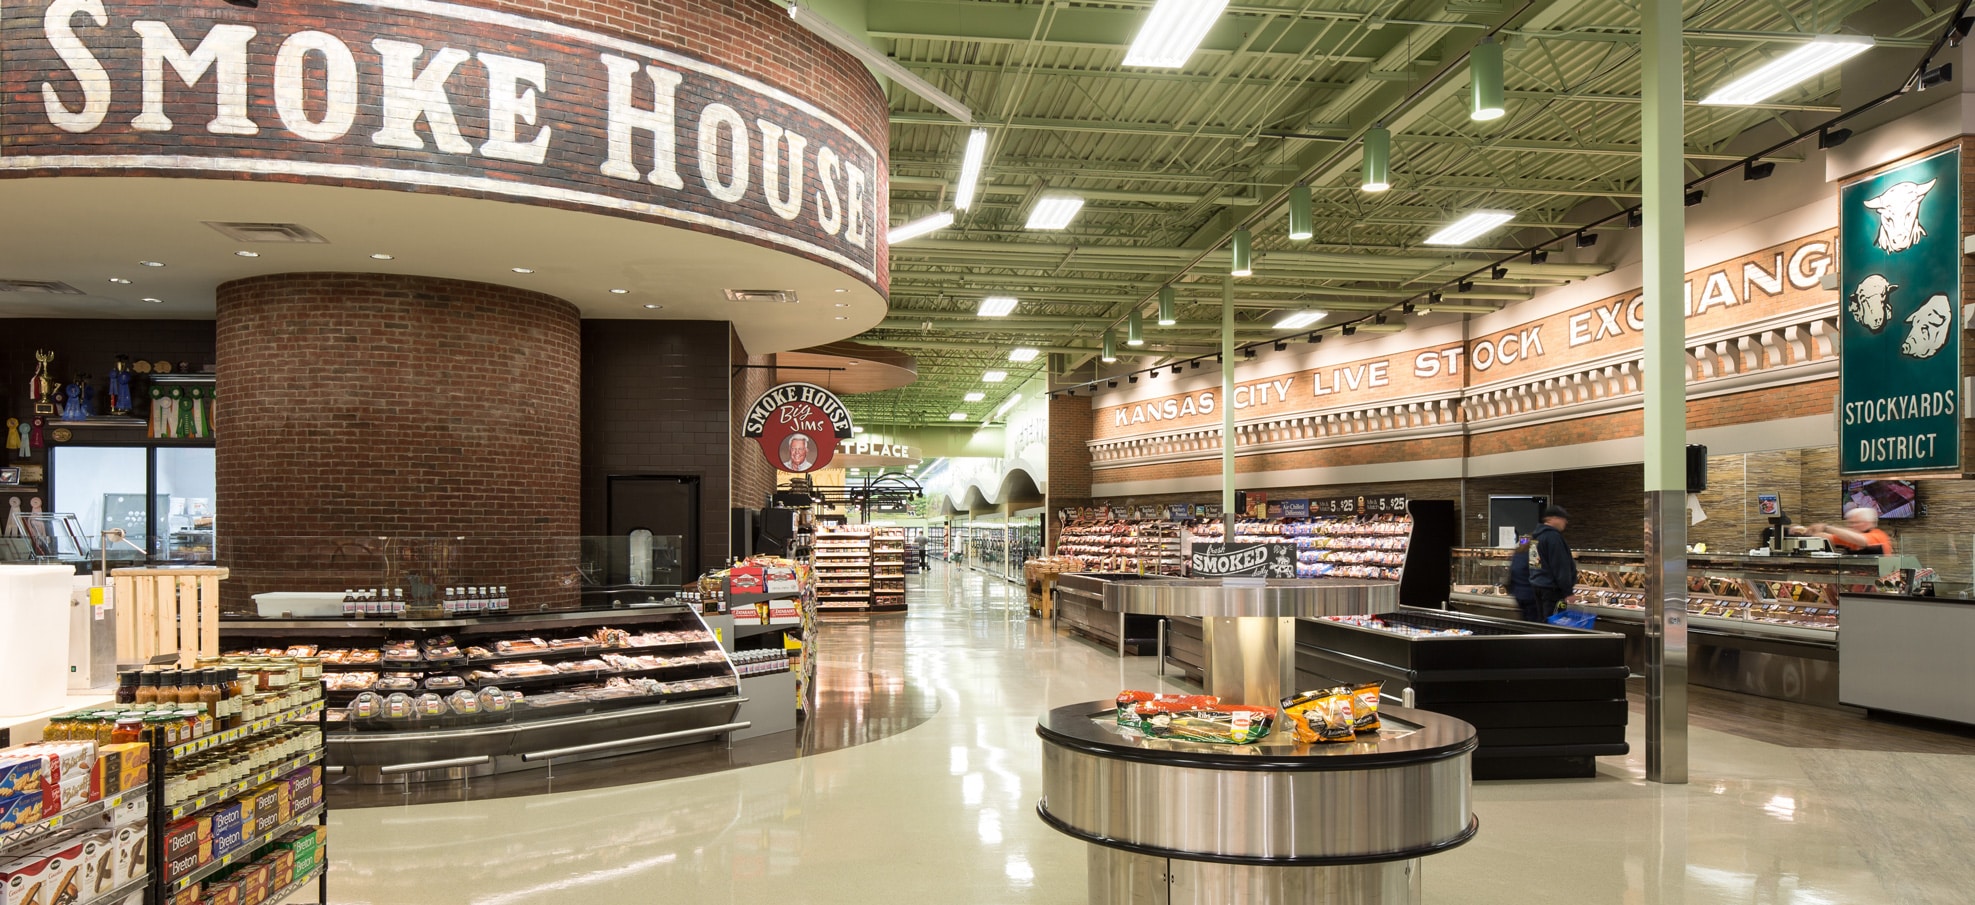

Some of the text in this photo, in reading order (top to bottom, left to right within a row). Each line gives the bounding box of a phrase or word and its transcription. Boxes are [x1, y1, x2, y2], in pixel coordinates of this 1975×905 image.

[42, 0, 868, 249] SMOKE HOUSE
[1115, 235, 1838, 427] KANSAS CITY LIVE STOCK EXCANG
[747, 386, 848, 434] SMOKE HOUSE
[780, 403, 813, 424] Big
[1846, 389, 1954, 425] STOCKYARDS
[1860, 433, 1936, 462] DISTRICT
[1330, 500, 1336, 512] 5
[1340, 499, 1353, 511] $25
[1379, 498, 1386, 511] 5
[1390, 497, 1405, 510] $25
[1192, 546, 1268, 573] SMOKED
[1206, 543, 1226, 558] fresh
[1251, 565, 1269, 579] daily
[295, 775, 312, 792] Breton
[258, 792, 277, 810] Breton
[295, 795, 312, 811] Breton
[217, 809, 240, 828] Breton
[258, 811, 278, 830] Breton
[172, 831, 197, 852] Breton
[218, 831, 241, 850] Breton
[296, 836, 315, 852] Breton
[172, 852, 198, 875] Breton
[296, 856, 313, 873] Breton
